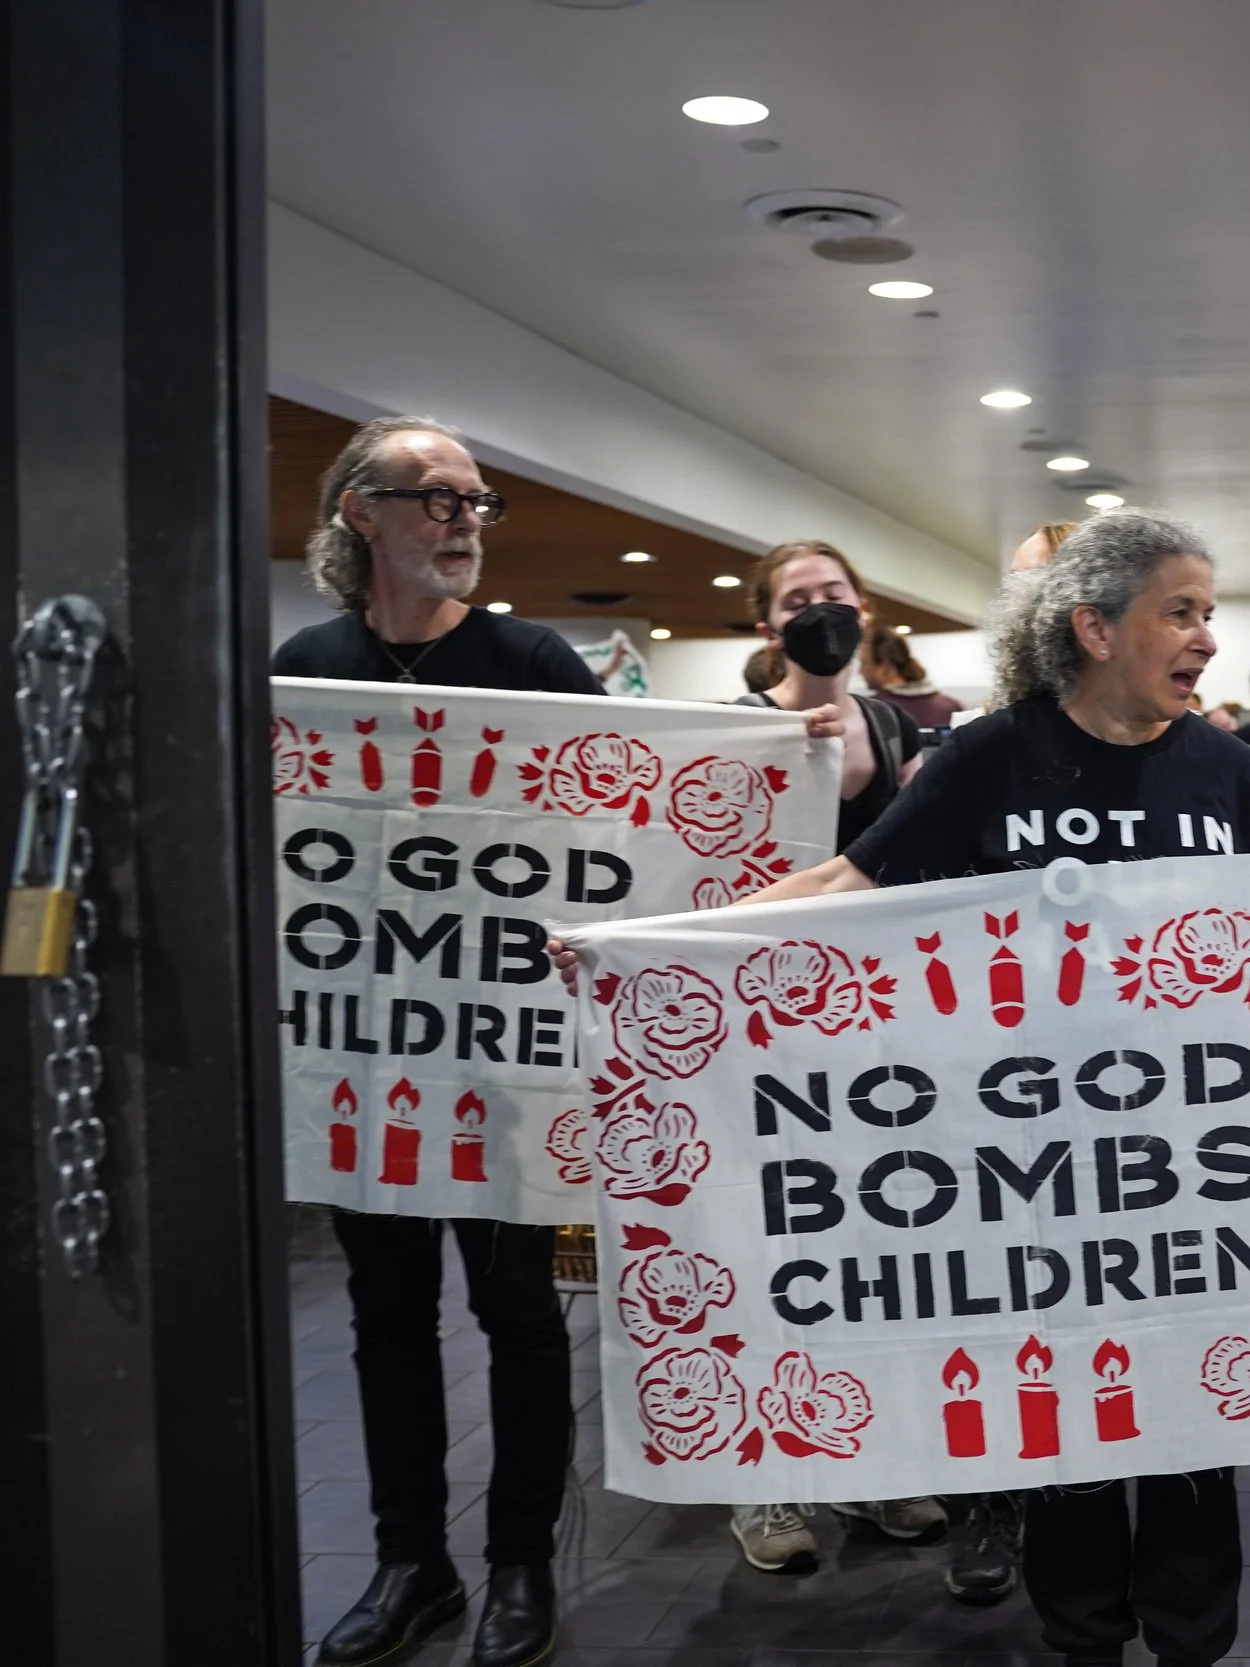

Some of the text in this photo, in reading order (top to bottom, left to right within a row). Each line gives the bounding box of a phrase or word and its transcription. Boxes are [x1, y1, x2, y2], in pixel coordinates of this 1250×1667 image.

[283, 828, 633, 904] O GOD
[1005, 808, 1235, 855] NOT IN
[283, 902, 553, 985] OMB
[752, 1064, 938, 1136] NO
